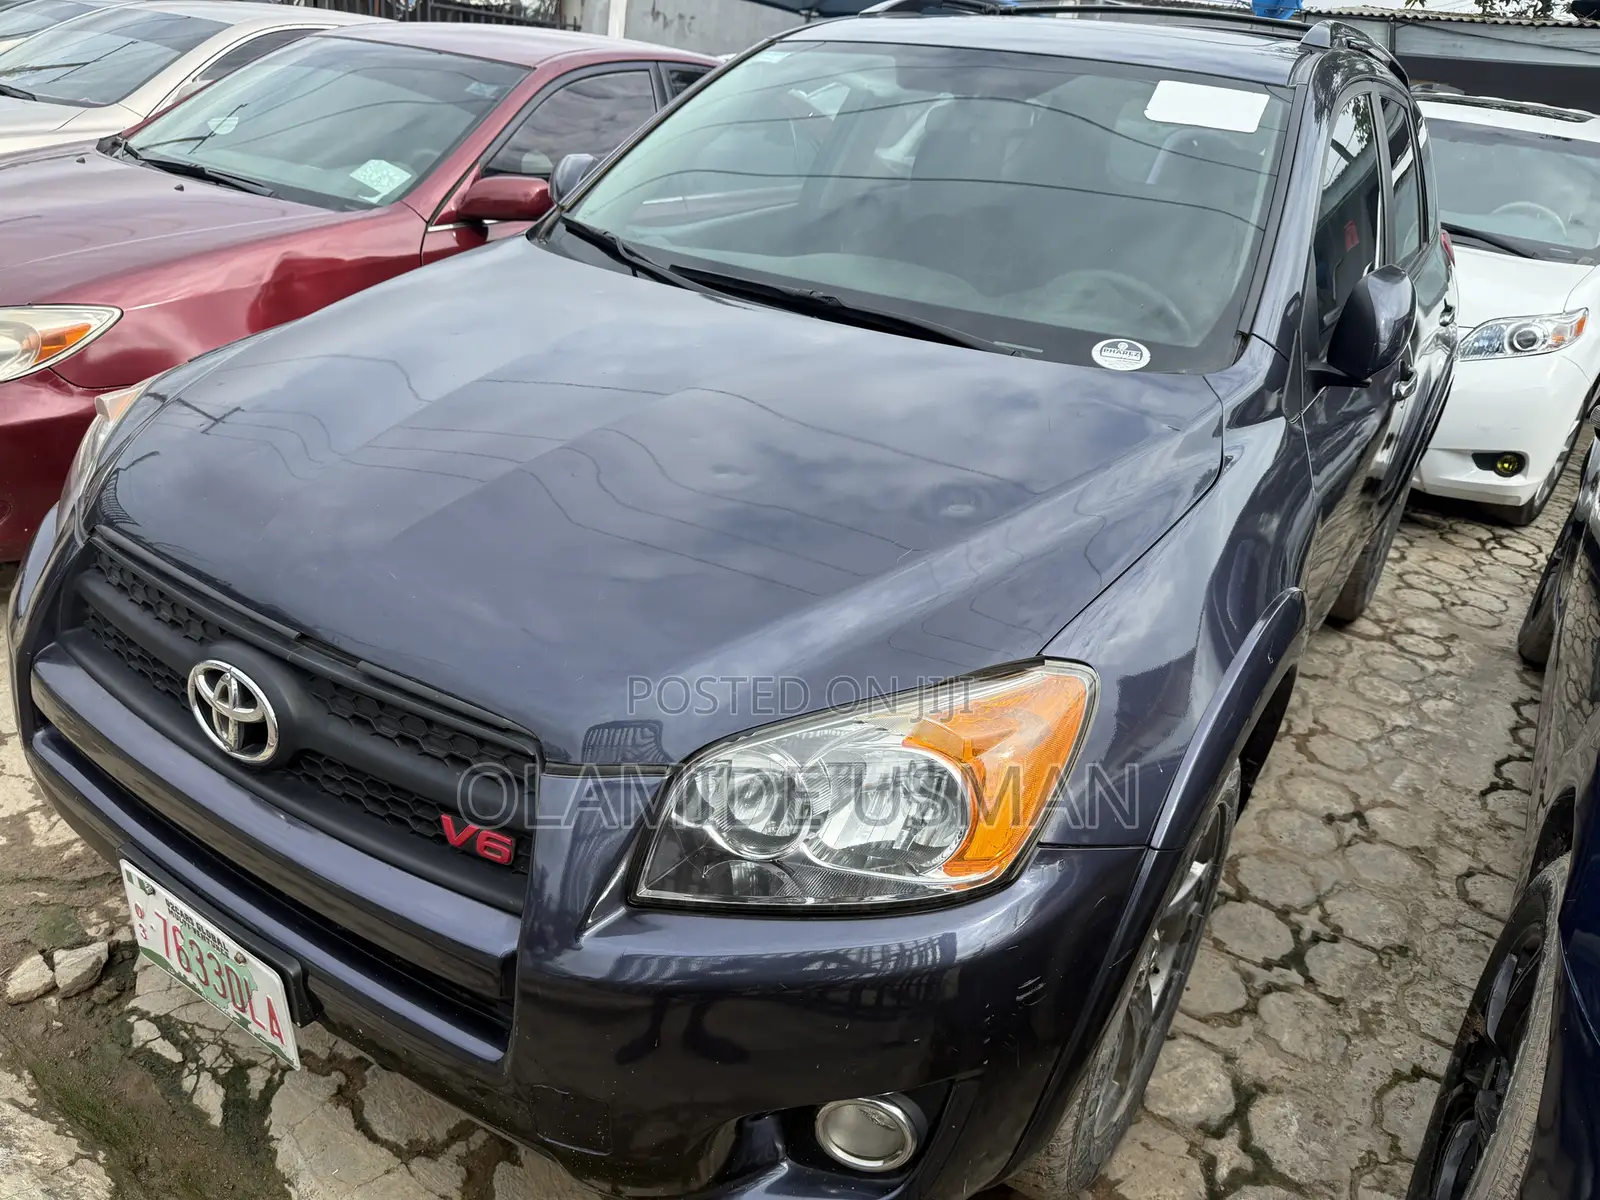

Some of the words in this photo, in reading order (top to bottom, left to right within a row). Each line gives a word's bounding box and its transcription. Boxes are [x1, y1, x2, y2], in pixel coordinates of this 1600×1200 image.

[1103, 348, 1140, 358] PHAREZ
[441, 813, 513, 865] V6
[195, 921, 229, 953] GLOBAL
